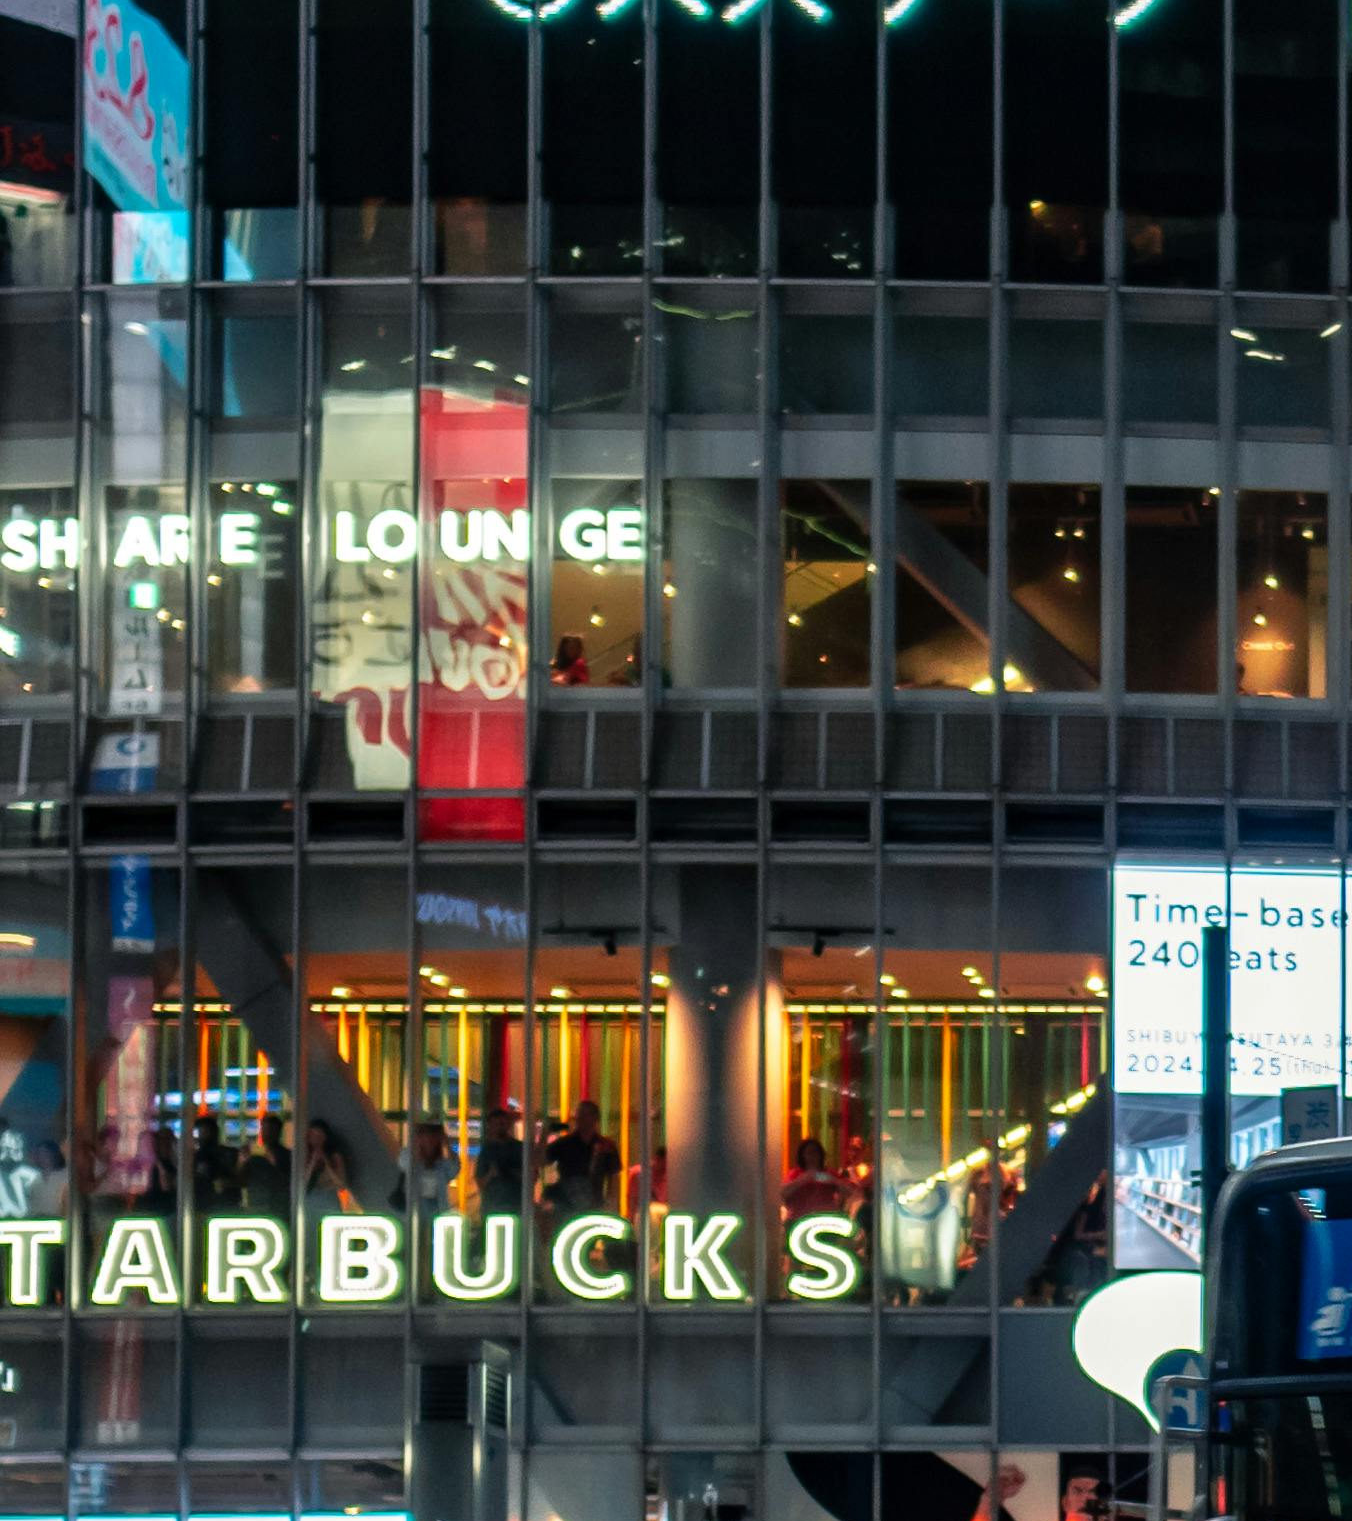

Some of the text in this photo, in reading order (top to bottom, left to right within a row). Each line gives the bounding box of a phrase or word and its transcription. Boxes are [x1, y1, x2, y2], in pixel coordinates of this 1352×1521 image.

[2, 506, 646, 573] SHARE LOUNGE
[1127, 939, 1299, 972] 240 eats
